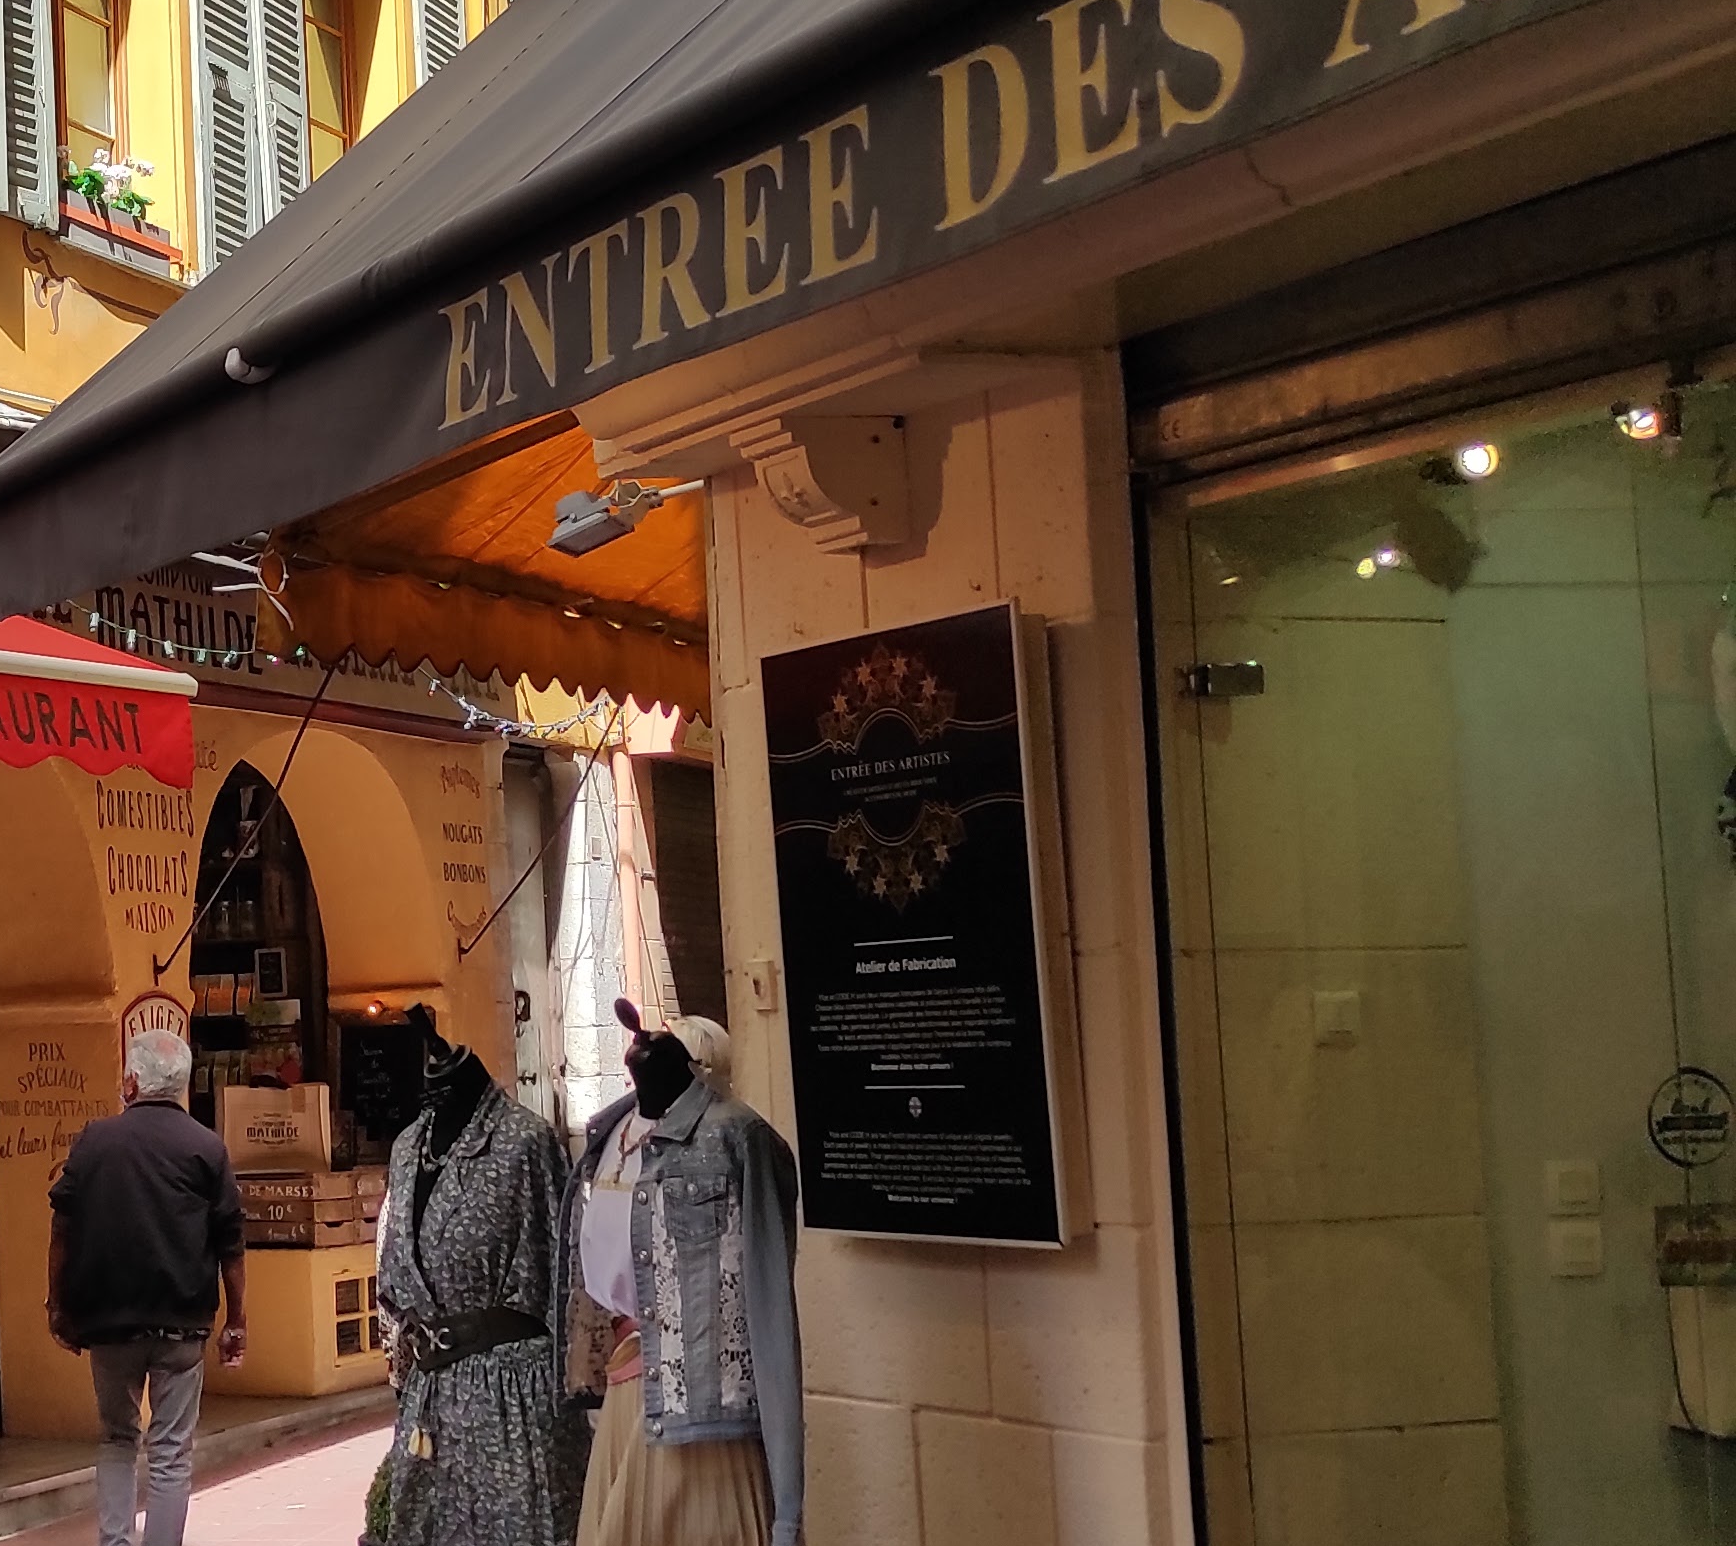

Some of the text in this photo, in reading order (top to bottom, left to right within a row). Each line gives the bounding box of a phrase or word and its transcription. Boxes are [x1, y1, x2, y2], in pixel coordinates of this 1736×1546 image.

[437, 103, 879, 432] ENTREE
[94, 585, 264, 676] MATHILDE
[96, 779, 195, 838] COMESTIBLES
[107, 845, 188, 897] CHOCOLATS
[443, 862, 486, 884] BONBONS
[125, 901, 175, 934] MAISON
[28, 1042, 66, 1062] PRIX
[17, 1064, 88, 1094] SPÉCIAUX
[24, 1099, 109, 1117] COMBATTANTS
[0, 1135, 13, 1159] et
[265, 1185, 314, 1198] MARSE
